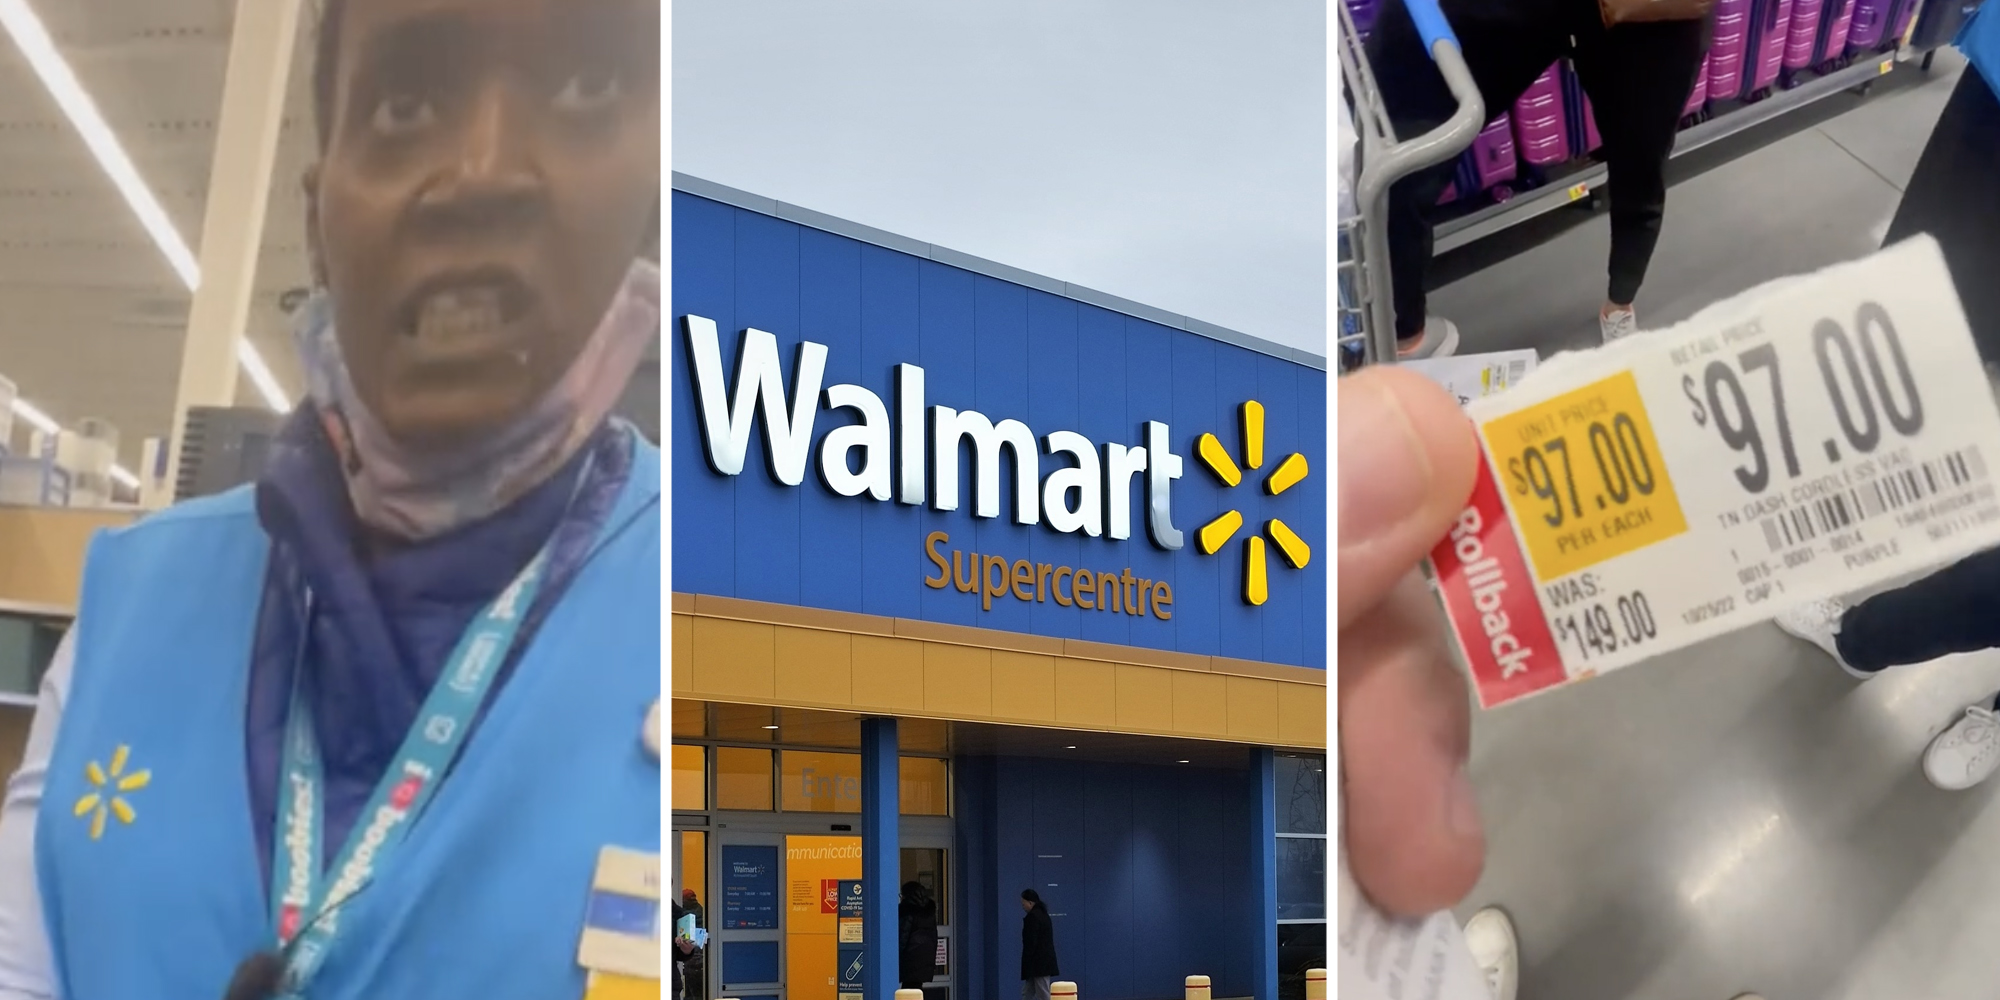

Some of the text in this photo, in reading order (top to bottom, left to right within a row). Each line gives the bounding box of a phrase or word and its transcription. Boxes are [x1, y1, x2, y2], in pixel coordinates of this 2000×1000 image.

[1722, 315, 1767, 348] PRICE
[683, 314, 1184, 551] Walmart
[1517, 396, 1609, 444] UNIT PRICE
[1681, 302, 1924, 494] $97.00
[1508, 412, 1656, 528] $97.00
[1556, 506, 1654, 555] PER EACH
[925, 530, 1174, 621] Supercentre
[1451, 505, 1534, 681] Rollback
[1547, 572, 1606, 609] WAS:
[1554, 589, 1658, 661] $149.00
[802, 767, 861, 801] Ente
